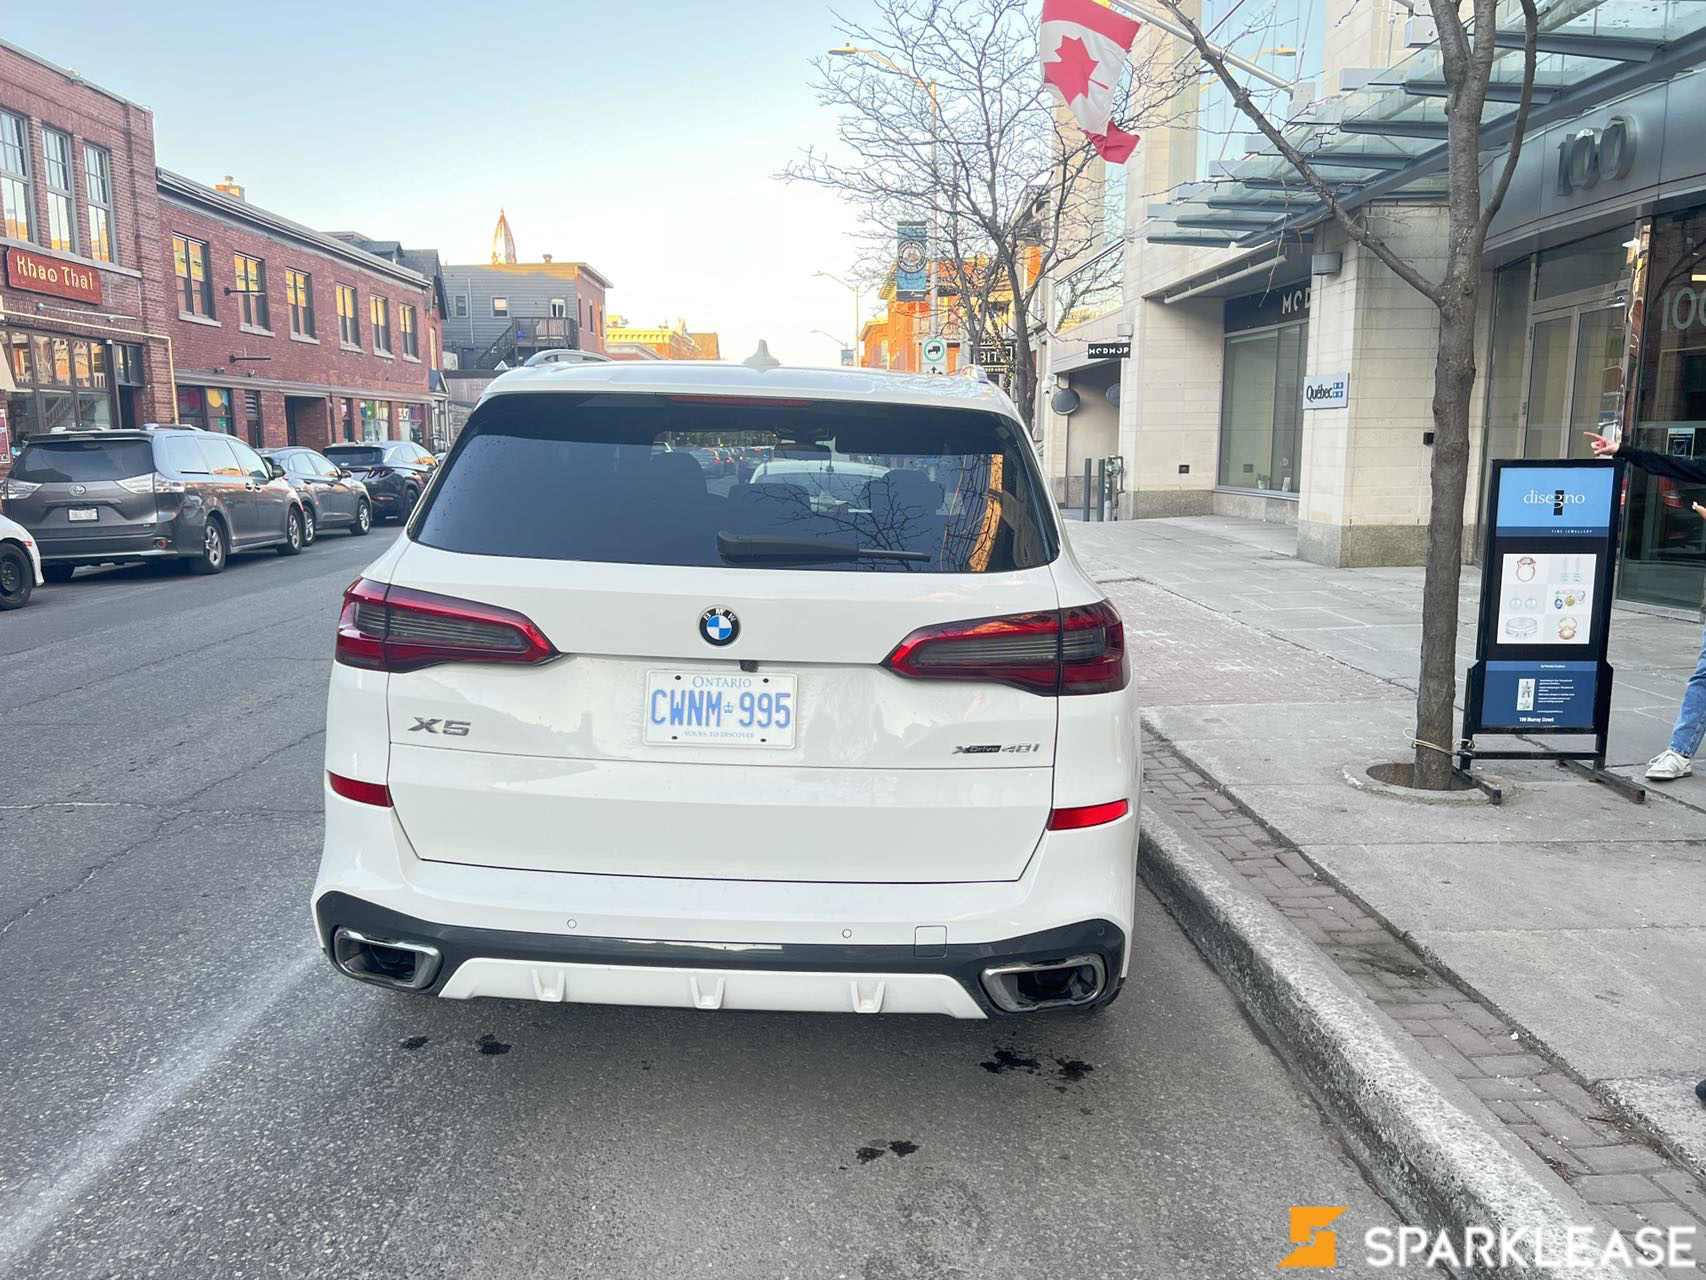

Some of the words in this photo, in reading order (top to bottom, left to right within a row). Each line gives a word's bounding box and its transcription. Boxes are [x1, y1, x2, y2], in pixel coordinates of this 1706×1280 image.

[1556, 115, 1638, 196] 100
[16, 255, 58, 282] Khao
[1661, 286, 1706, 336] 10
[1523, 489, 1586, 509] disegno
[651, 688, 723, 727] CWNM
[738, 691, 792, 729] 995
[407, 716, 472, 737] X5
